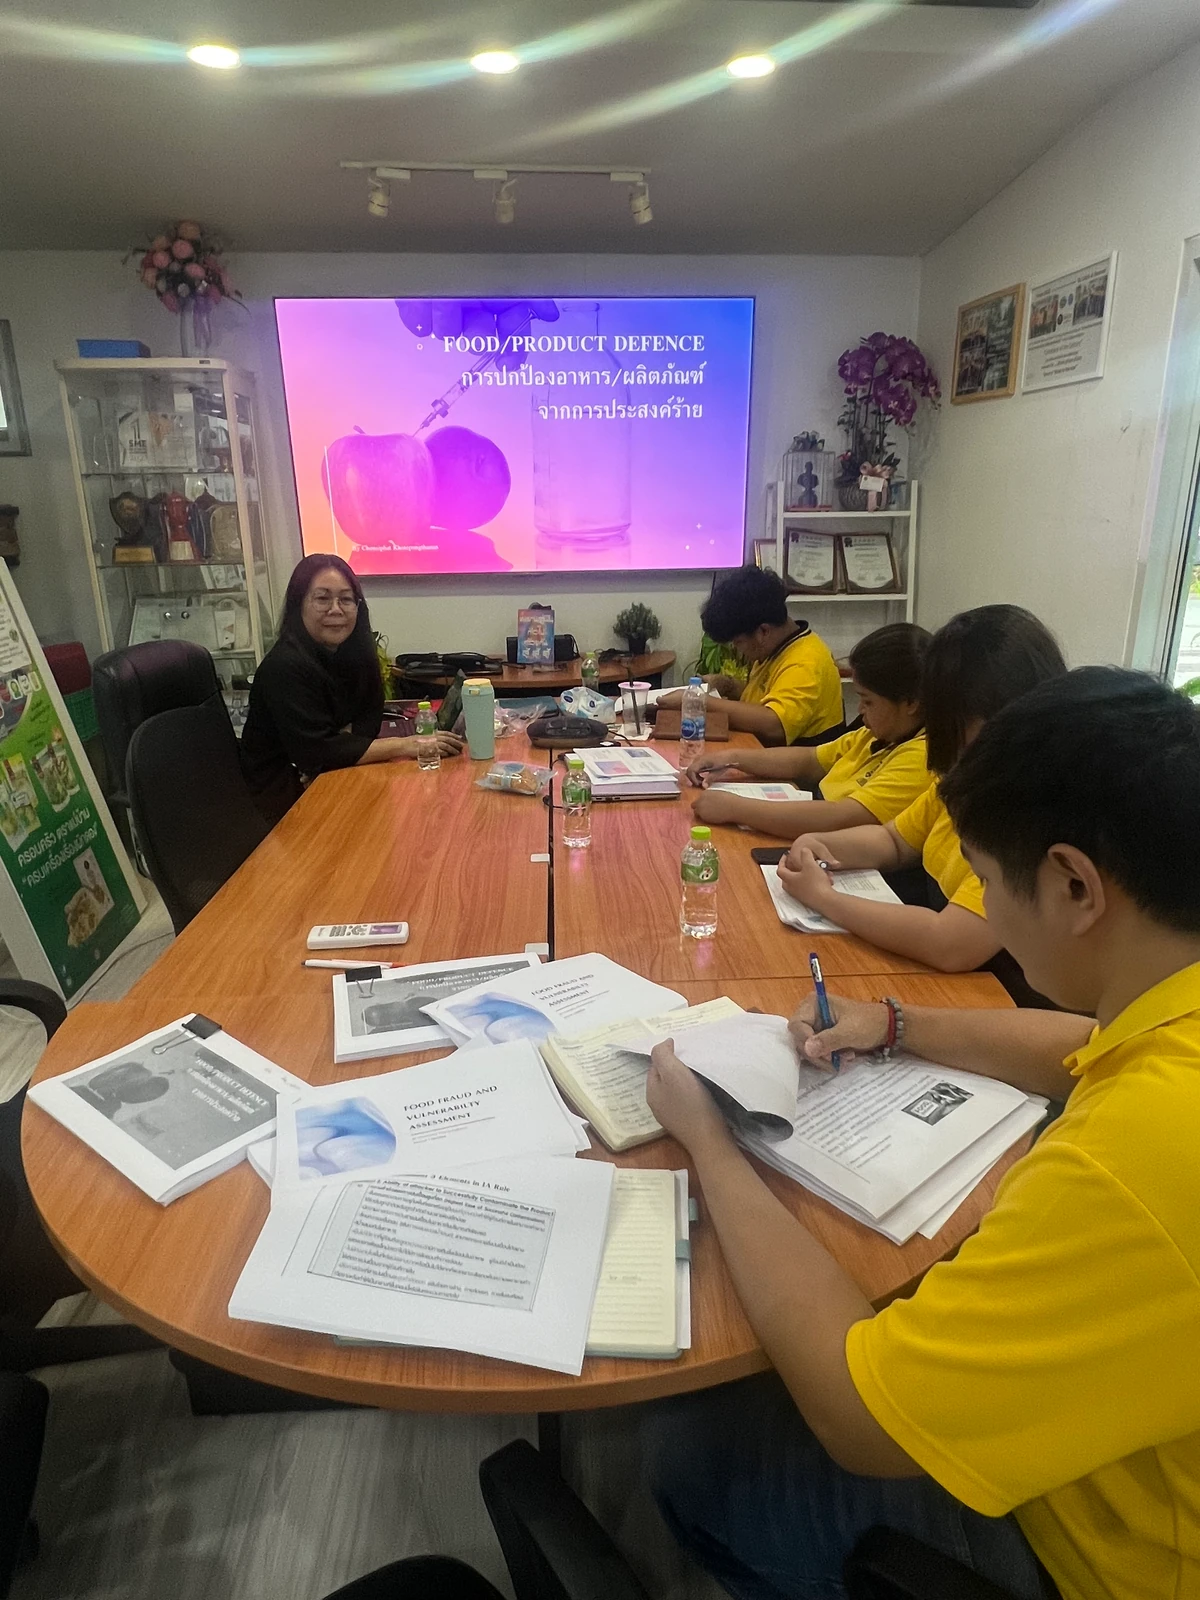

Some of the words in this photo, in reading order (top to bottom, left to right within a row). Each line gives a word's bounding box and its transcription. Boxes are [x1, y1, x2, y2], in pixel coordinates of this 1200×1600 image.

[443, 335, 607, 354] FOOD/PRODUCT
[613, 334, 706, 352] DEFENCE
[461, 361, 707, 387] การปกป้องอาหาร/ผลิตภัณฑ์
[538, 396, 704, 420] จากการประสงค์ร้าย
[403, 1099, 435, 1112] FOOD
[437, 1091, 472, 1104] FRAUD
[475, 1085, 498, 1096] AND
[409, 1112, 471, 1131] ASSESSMENT
[482, 1181, 491, 1189] IA
[493, 1183, 511, 1193] Rule
